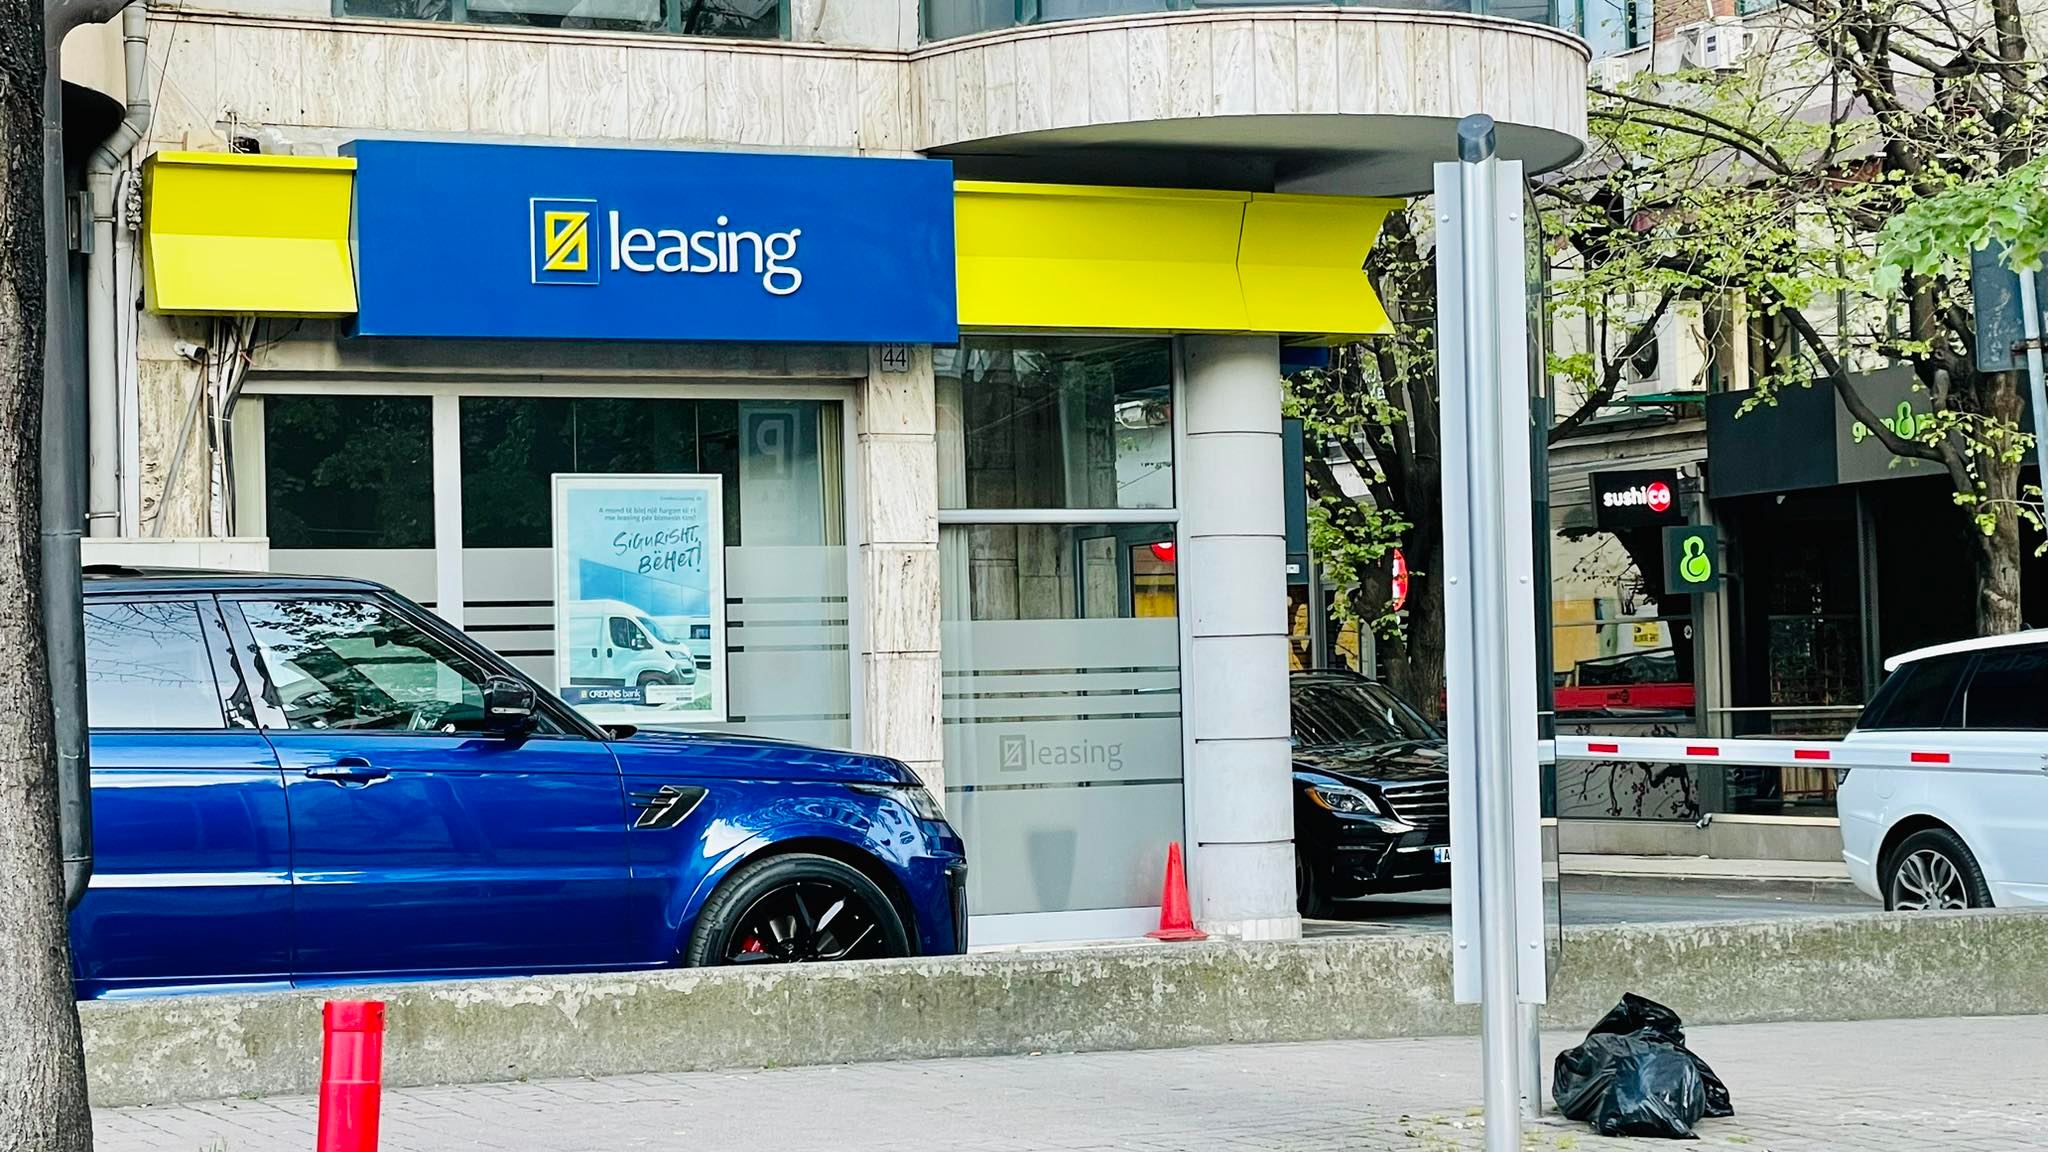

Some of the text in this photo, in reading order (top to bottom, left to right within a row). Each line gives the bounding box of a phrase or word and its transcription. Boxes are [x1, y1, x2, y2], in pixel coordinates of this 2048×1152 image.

[609, 210, 803, 296] leasing
[883, 348, 907, 367] 44
[1603, 484, 1671, 509] sushico
[589, 689, 622, 699] CREDINS
[622, 688, 641, 699] bank
[1030, 739, 1123, 771] leasing
